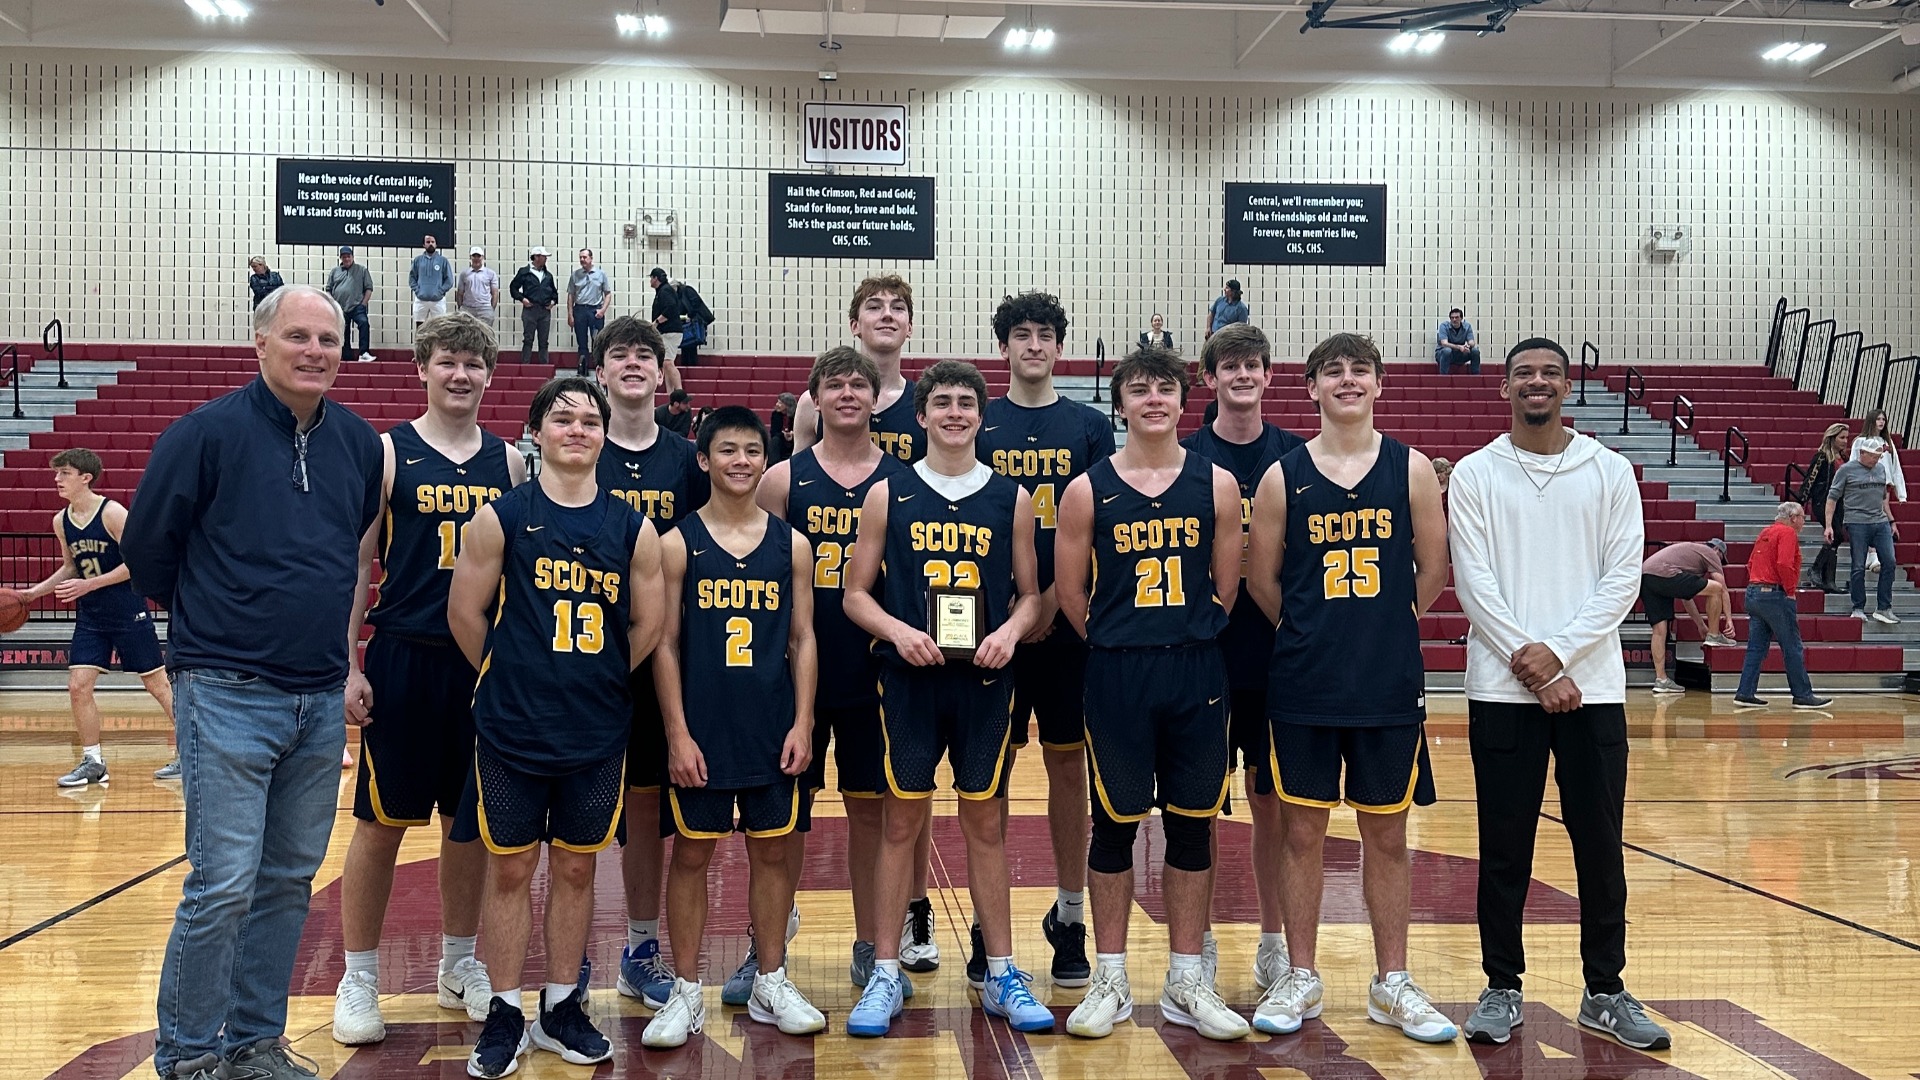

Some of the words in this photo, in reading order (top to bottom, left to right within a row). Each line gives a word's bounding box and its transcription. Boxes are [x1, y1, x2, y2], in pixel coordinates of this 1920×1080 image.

[809, 117, 901, 151] VISITORS
[299, 173, 319, 184] Hear
[321, 173, 336, 184] the
[338, 174, 361, 185] voice
[363, 175, 373, 185] of
[374, 175, 406, 186] Central
[408, 176, 432, 189] High;
[311, 190, 339, 203] strong
[342, 191, 368, 201] sound
[370, 191, 387, 202] will
[389, 194, 414, 203] never
[416, 192, 432, 203] die.
[787, 186, 804, 196] Hail
[805, 187, 820, 197] the
[821, 187, 858, 199] Crimson,
[859, 188, 876, 198] Red
[877, 188, 893, 198] and
[894, 188, 916, 200] Gold;
[1248, 195, 1281, 207] Central,
[1282, 196, 1302, 206] we'll
[1303, 196, 1345, 207] remember
[283, 205, 305, 216] We'll
[307, 206, 332, 217] stand
[334, 208, 362, 220] strong
[364, 208, 385, 218] with
[387, 208, 398, 219] all
[400, 211, 415, 219] our
[417, 209, 446, 222] might,
[785, 202, 810, 212] Stand
[811, 202, 824, 213] for
[825, 203, 853, 215] Honor,
[854, 203, 878, 214] brave
[879, 204, 895, 214] and
[896, 204, 918, 215] bold.
[1243, 211, 1253, 221] All
[1256, 211, 1269, 221] the
[1271, 211, 1316, 224] friendships
[1318, 212, 1330, 222] old
[1332, 212, 1347, 222] and
[1350, 214, 1368, 222] new.
[344, 223, 365, 236] CHS,
[366, 224, 386, 235] CHS.
[788, 218, 809, 229] She's
[810, 218, 825, 229] the
[826, 220, 845, 231] past
[862, 219, 889, 230] future
[890, 220, 915, 232] holds,
[1253, 227, 1285, 238] Forever,
[1286, 227, 1301, 237] the
[1302, 227, 1340, 238] mem'ries
[1341, 227, 1358, 239] live,
[833, 235, 850, 247] CHS,
[853, 235, 871, 246] CHS.
[1286, 243, 1305, 254] CHS,
[1306, 243, 1325, 253] CHS.
[992, 448, 1072, 477] SCOTS
[1113, 517, 1199, 553] SCOTS
[1308, 508, 1392, 544] SCOTS
[437, 521, 471, 570] 1
[910, 521, 993, 557] SCOTS
[80, 557, 102, 579] 21
[1323, 547, 1381, 599] 25
[535, 557, 620, 604] SCOTS
[1135, 556, 1185, 607] 21
[698, 579, 779, 610] SCOTS
[552, 600, 604, 654] 13
[726, 616, 753, 666] 2
